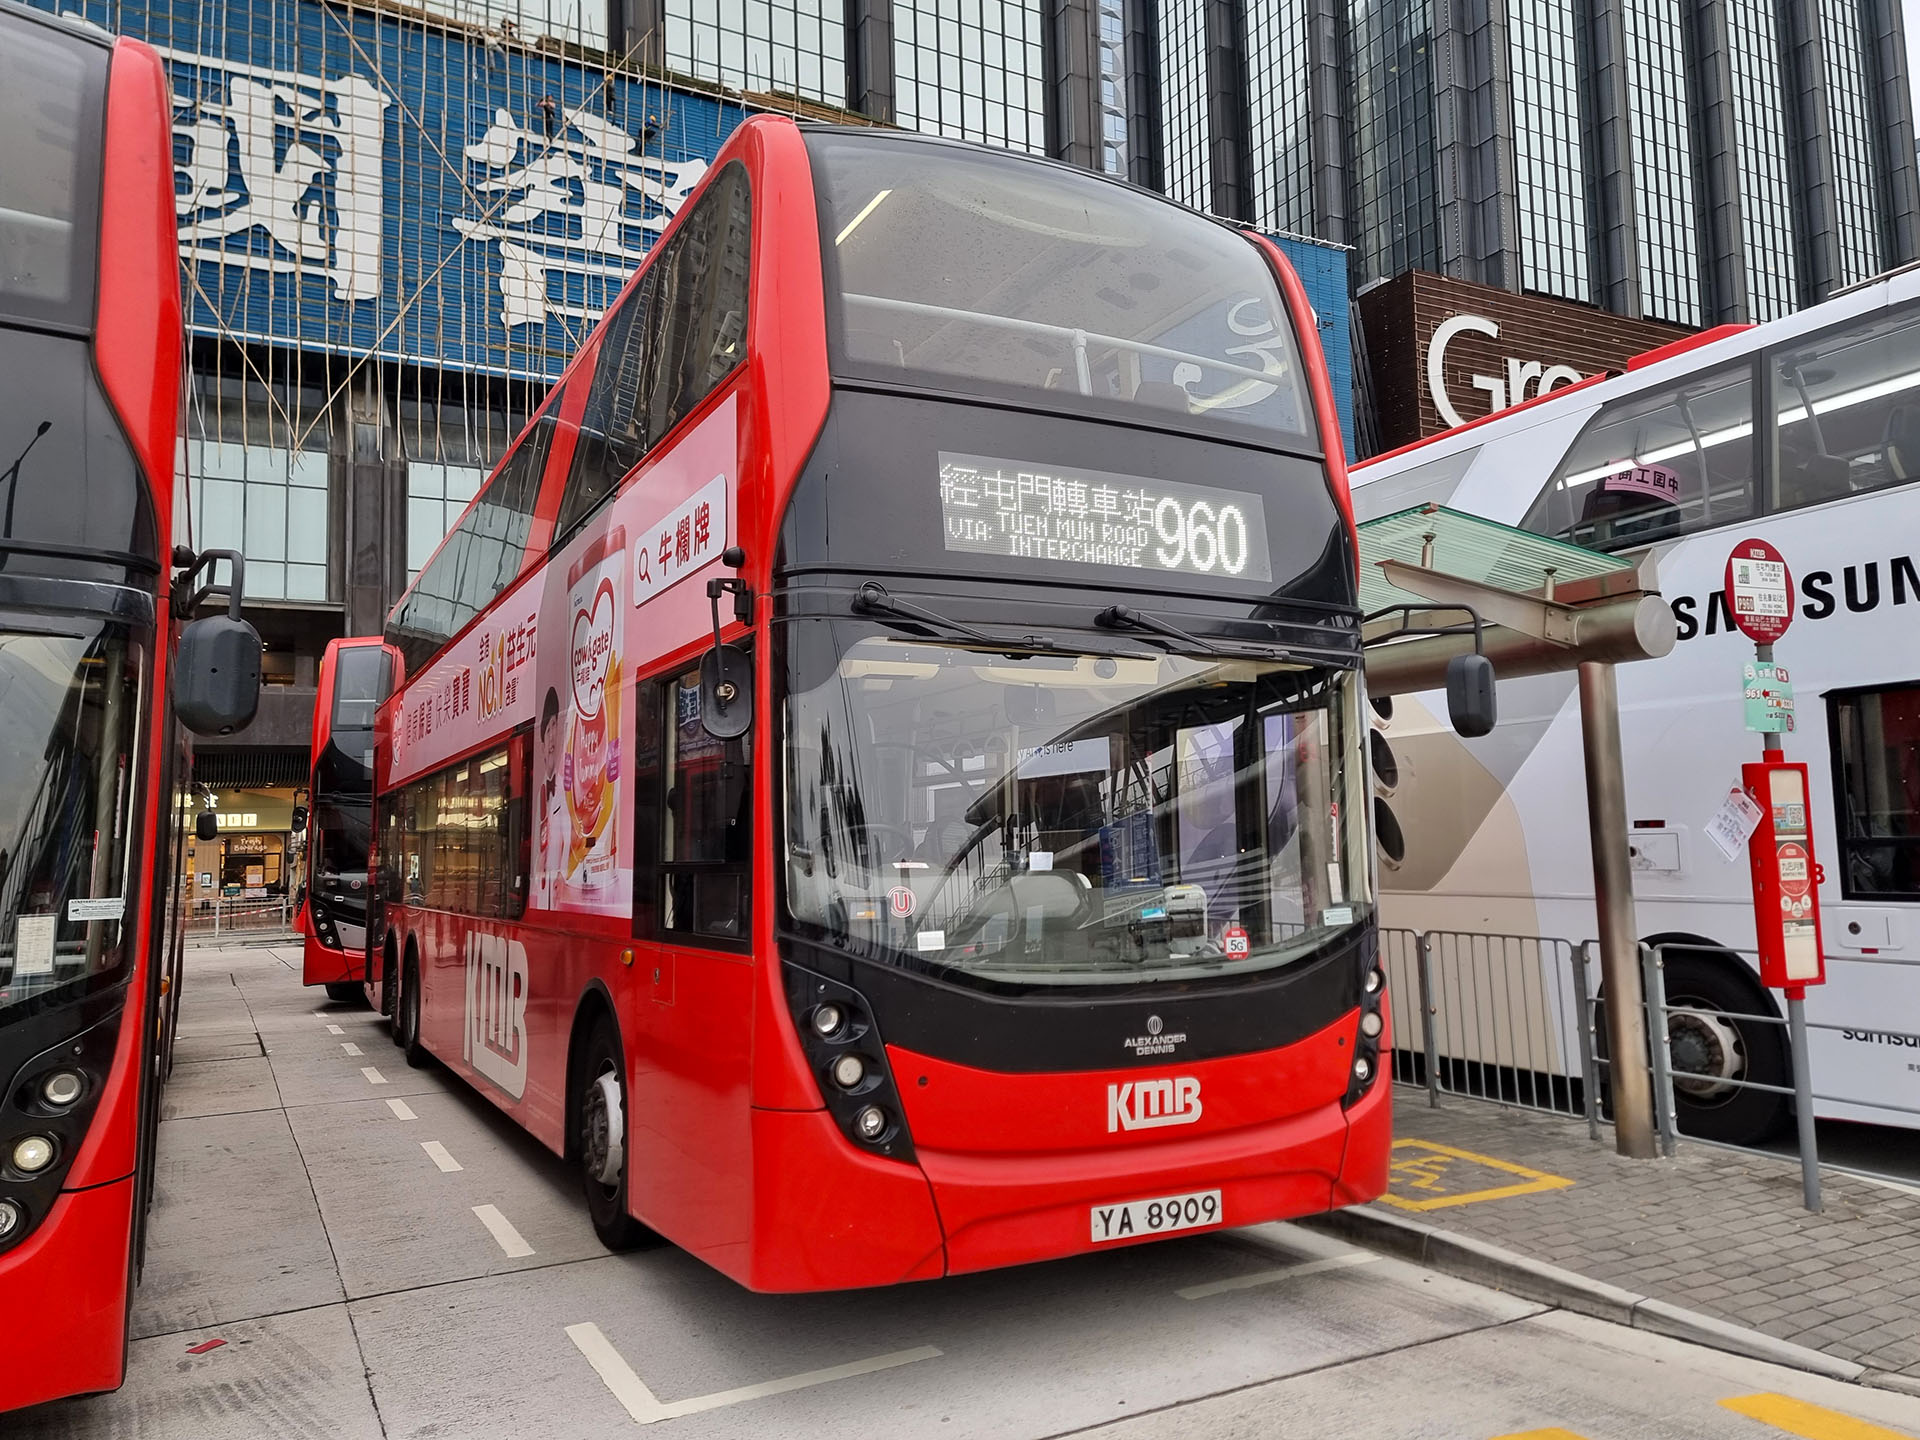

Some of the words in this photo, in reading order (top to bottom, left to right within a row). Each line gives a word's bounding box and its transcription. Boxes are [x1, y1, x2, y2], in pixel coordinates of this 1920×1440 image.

[940, 462, 1156, 527] 經屯門轉車站
[658, 501, 711, 577] 牛欄牌
[948, 516, 994, 540] VIA:
[995, 511, 1049, 538] TUEN
[1056, 518, 1096, 543] MUN
[1101, 523, 1149, 548] ROAD
[1009, 534, 1144, 568] INTERCHANGE
[1155, 497, 1248, 575] 960
[1671, 556, 1920, 641] SASUN
[506, 612, 537, 674] 益生元
[1230, 939, 1244, 952] 5G
[463, 930, 529, 1100] KMB
[1124, 1033, 1187, 1048] ALEXANDER
[1136, 1044, 1176, 1056] DENNIS
[1108, 1077, 1203, 1133] KMB
[1098, 1207, 1134, 1238] YA
[1147, 1195, 1217, 1230] 8909
